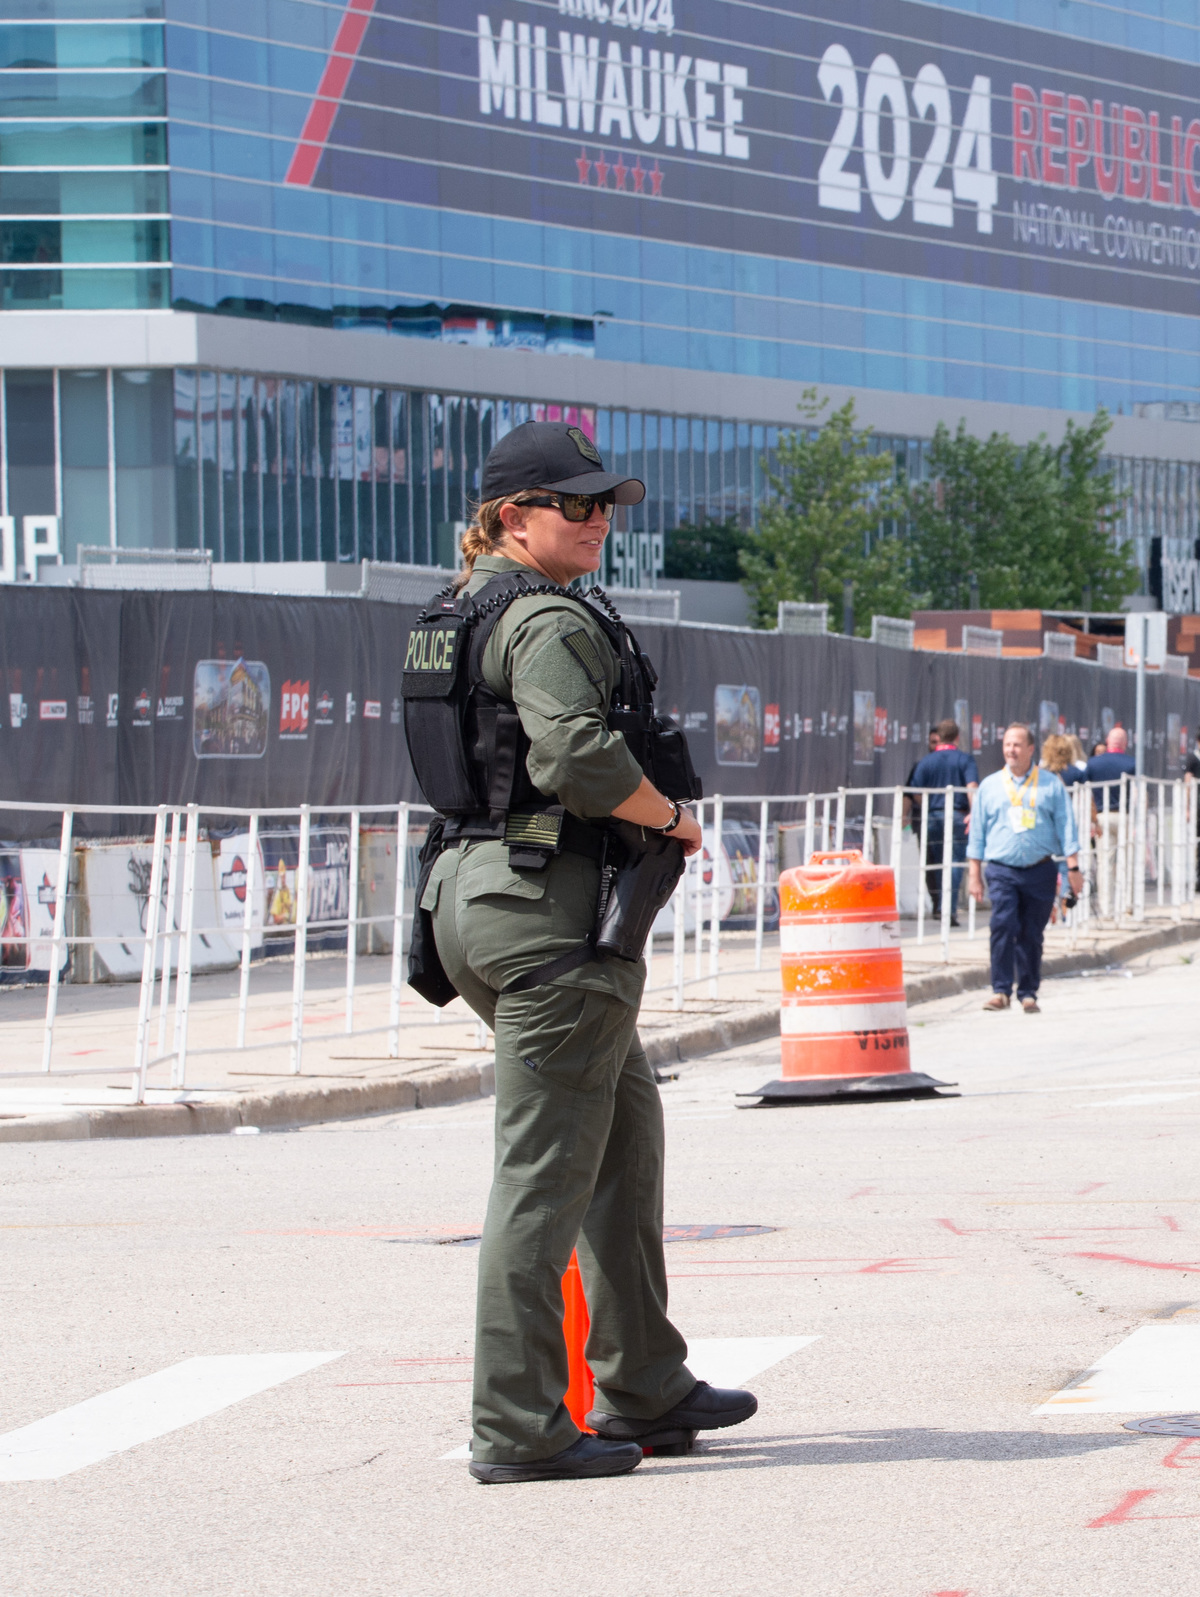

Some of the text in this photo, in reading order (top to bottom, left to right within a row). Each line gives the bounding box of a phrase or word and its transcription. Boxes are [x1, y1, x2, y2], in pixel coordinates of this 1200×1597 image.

[477, 14, 750, 160] MILWAUKEE
[817, 43, 998, 234] 2024
[1012, 200, 1101, 254] NATIONAL
[611, 531, 664, 590] SHOP
[403, 630, 456, 670] POLICE
[281, 693, 309, 720] FPC
